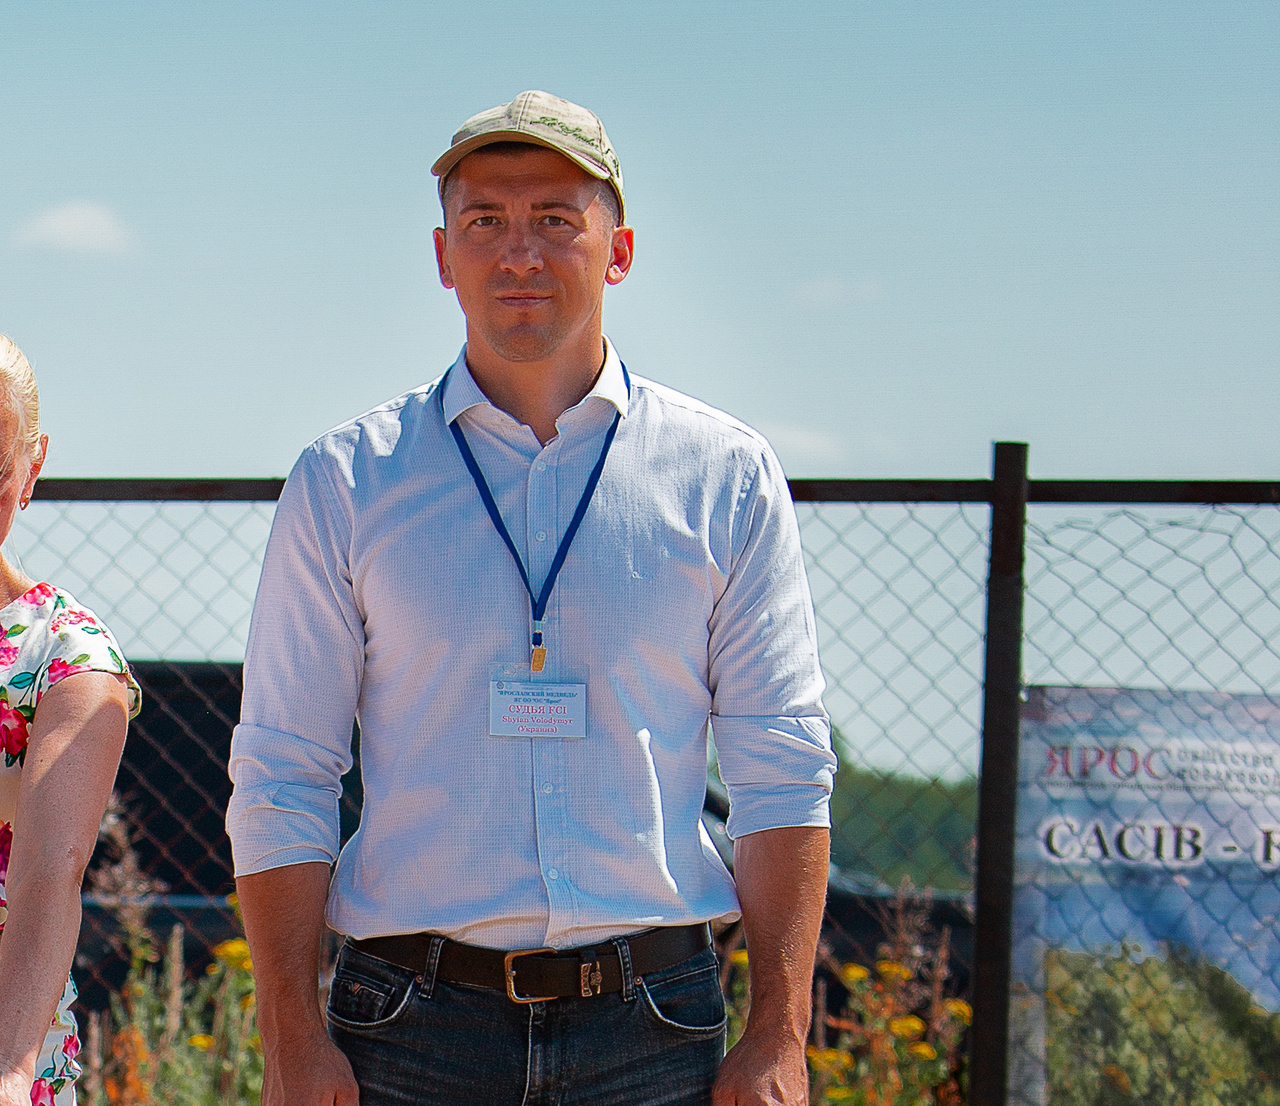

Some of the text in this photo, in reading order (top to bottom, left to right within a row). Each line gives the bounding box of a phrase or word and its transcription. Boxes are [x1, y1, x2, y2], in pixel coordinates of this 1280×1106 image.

[508, 705, 567, 714] СУДЬЯ FCI
[531, 716, 573, 725] Volodymyr
[518, 725, 558, 733] (Украина)
[1045, 746, 1174, 781] ЯРОС
[1045, 821, 1203, 861] CACIB
